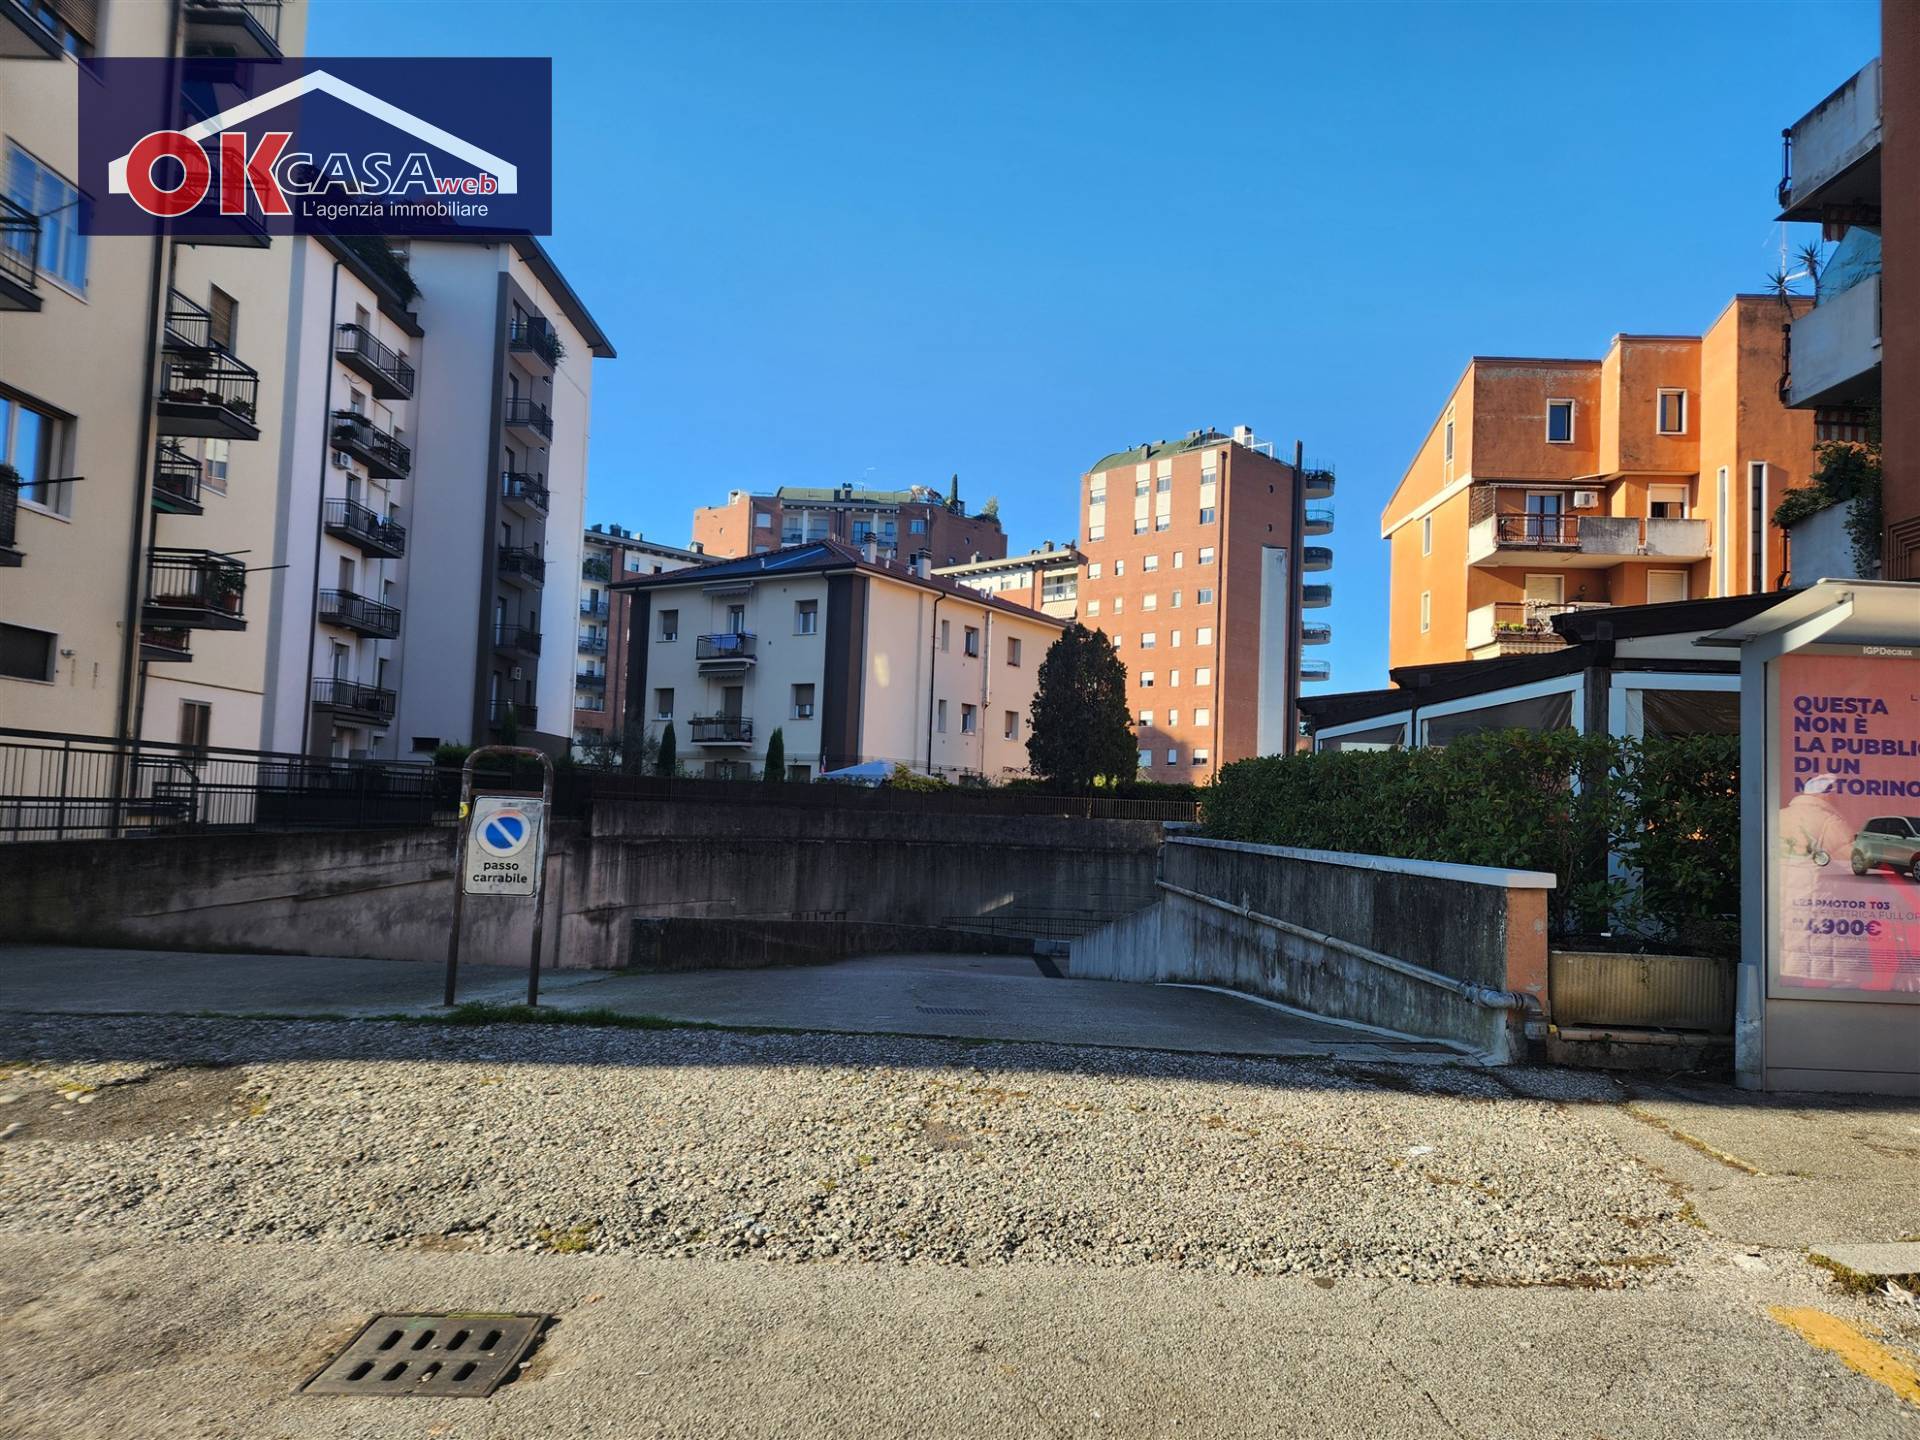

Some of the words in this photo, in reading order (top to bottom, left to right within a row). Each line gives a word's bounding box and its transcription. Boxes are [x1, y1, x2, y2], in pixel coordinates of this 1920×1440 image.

[1863, 646, 1913, 657] IGPDecaux
[1793, 695, 1889, 715] QUESTA
[1794, 716, 1847, 733] NON
[1854, 714, 1868, 734] È
[1794, 736, 1826, 753] LA
[1831, 738, 1920, 757] PUBBLI
[1794, 757, 1819, 773] DI
[1826, 758, 1860, 774] UN
[484, 861, 519, 871] passo
[472, 872, 528, 884] carrabile
[1870, 901, 1890, 910] T03
[1878, 911, 1904, 921] FULL
